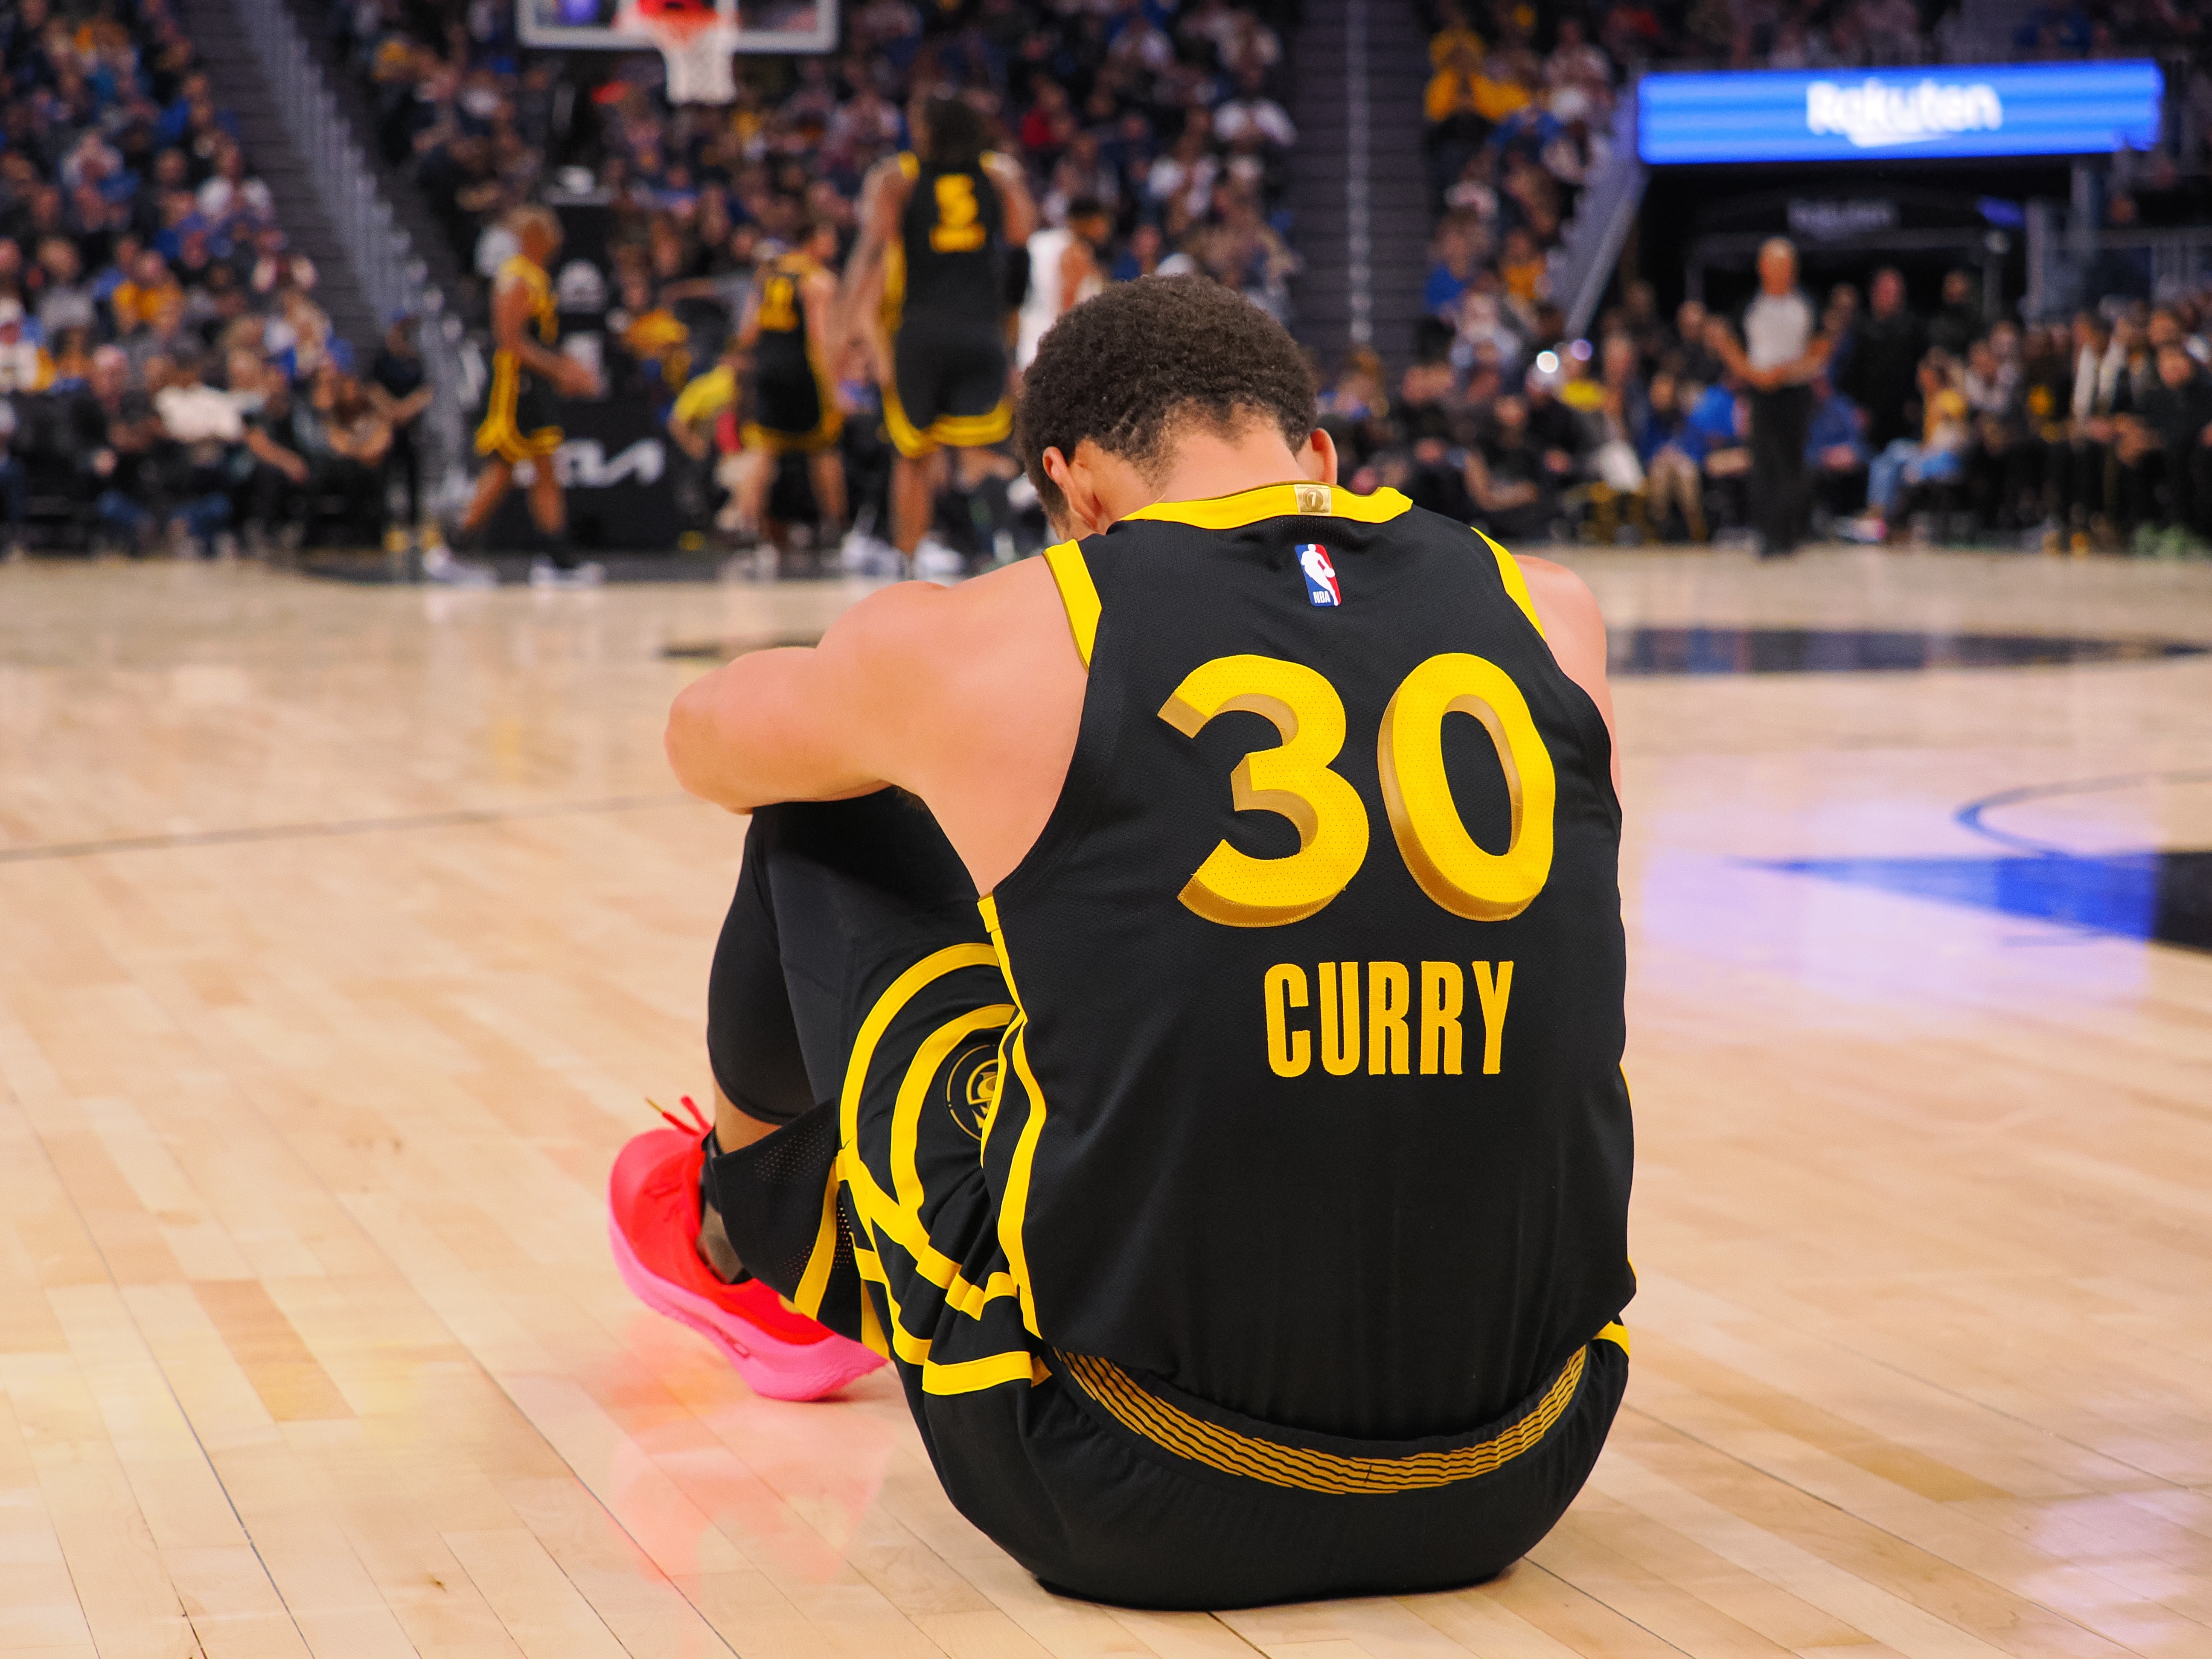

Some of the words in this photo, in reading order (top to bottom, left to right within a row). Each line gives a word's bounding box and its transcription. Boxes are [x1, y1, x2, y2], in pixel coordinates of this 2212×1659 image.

[1806, 78, 2003, 136] Rakuten
[1309, 491, 1317, 506] 7
[1313, 591, 1331, 603] NBA
[1157, 652, 1556, 927] 30
[1264, 960, 1514, 1078] CURRY
